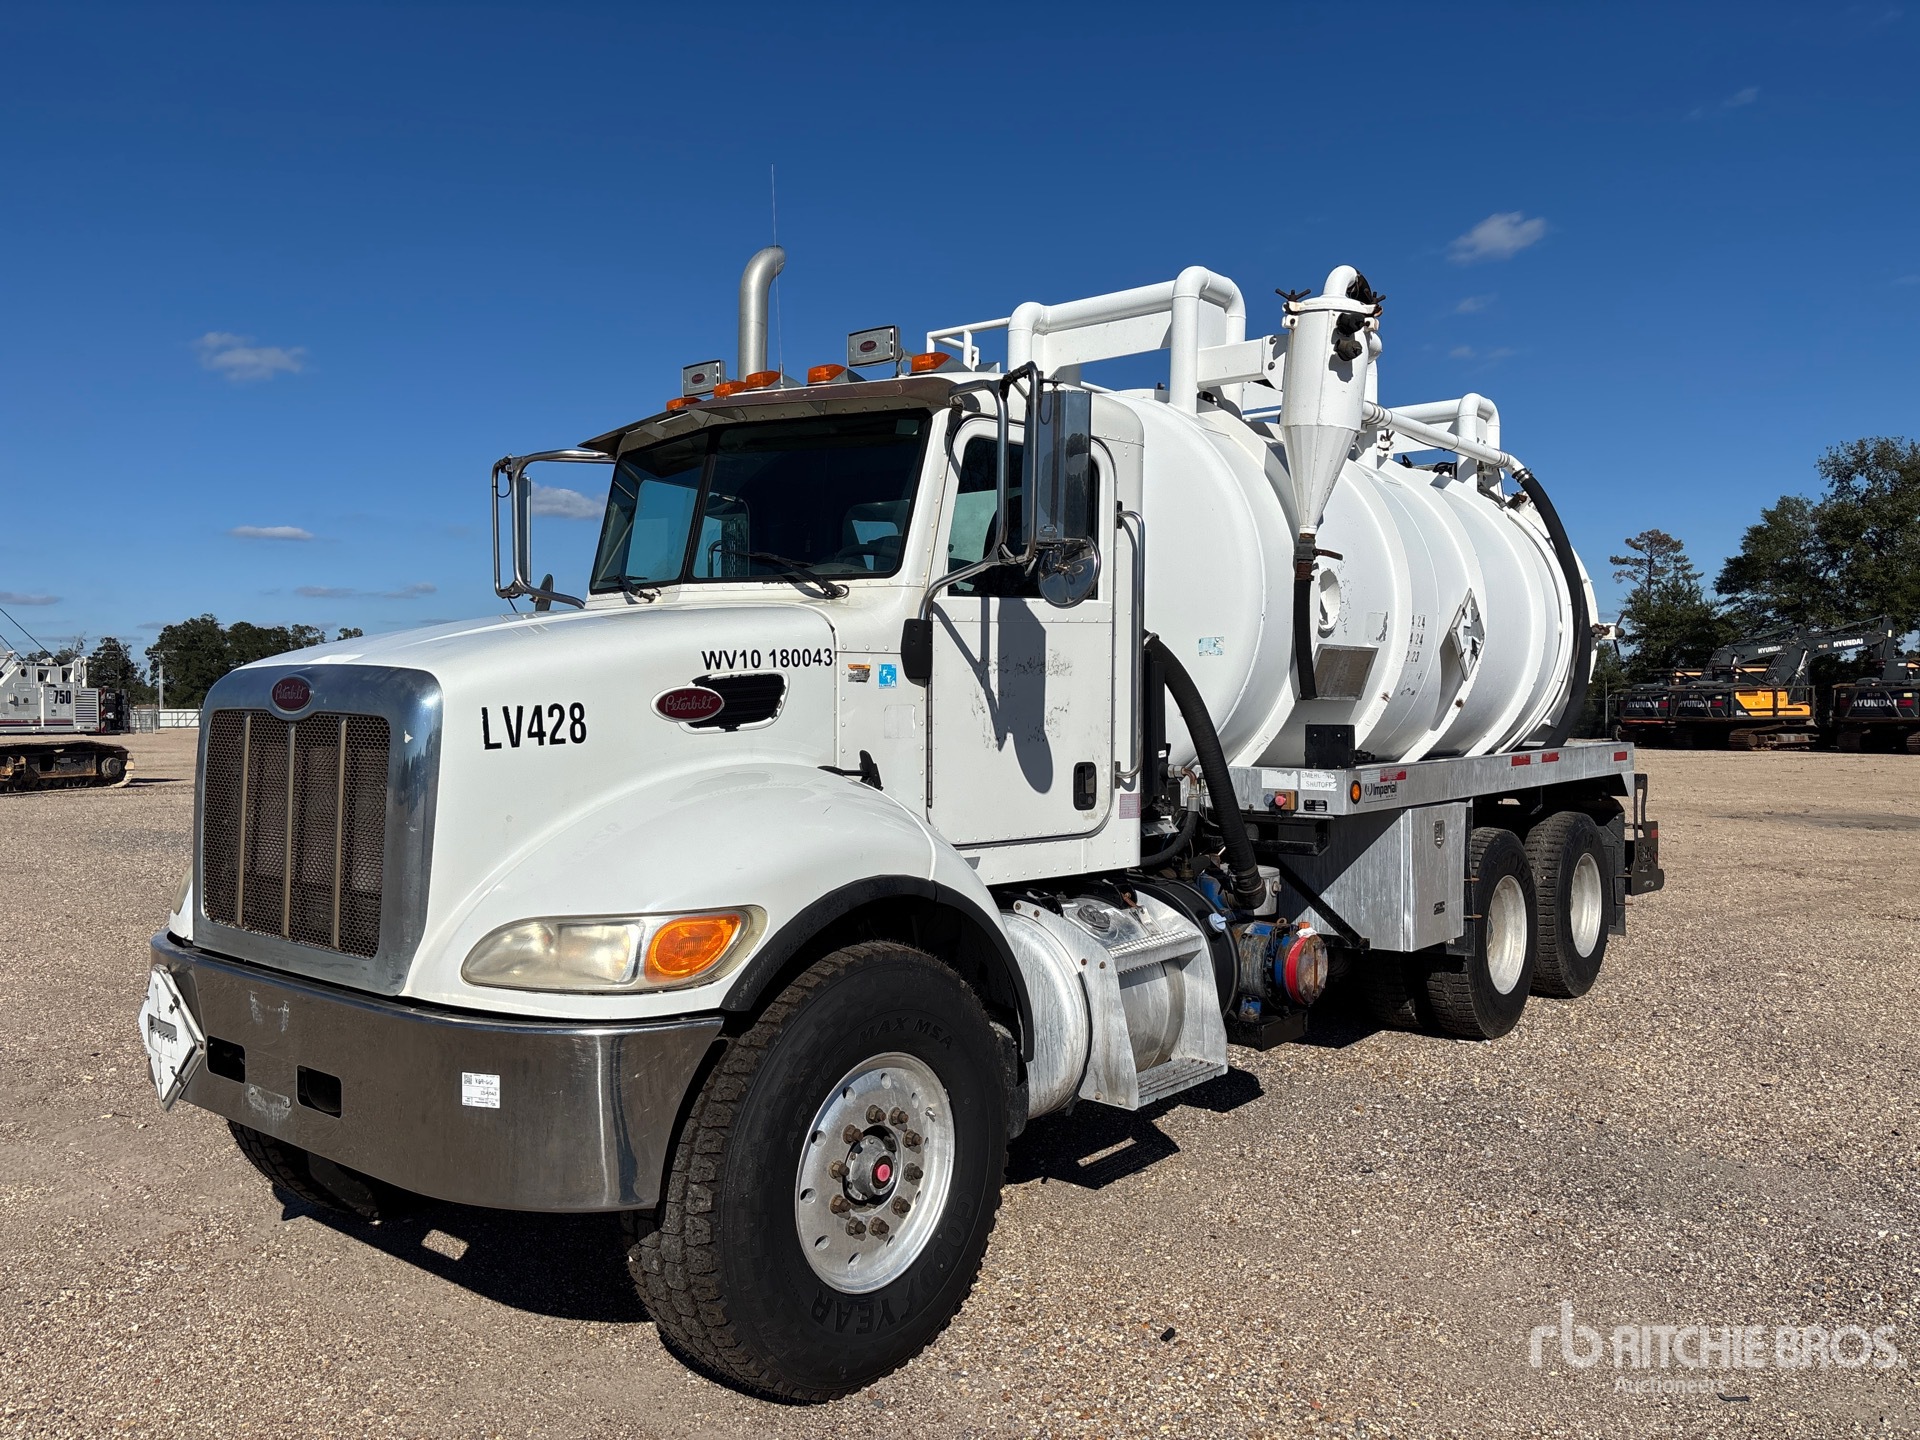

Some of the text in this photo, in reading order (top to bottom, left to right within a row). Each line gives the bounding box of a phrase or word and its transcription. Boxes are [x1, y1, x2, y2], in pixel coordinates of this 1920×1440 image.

[1833, 638, 1863, 648] HYUNDAI
[701, 647, 833, 670] WV10 180043
[53, 690, 72, 704] 750
[274, 683, 307, 700] Peterbilt
[664, 694, 717, 712] Peterbilt
[481, 702, 587, 750] LV428
[1305, 780, 1333, 788] SHUTOFF
[1373, 781, 1398, 798] Imperial
[858, 1016, 911, 1047] MAX
[912, 1017, 955, 1050] MSA
